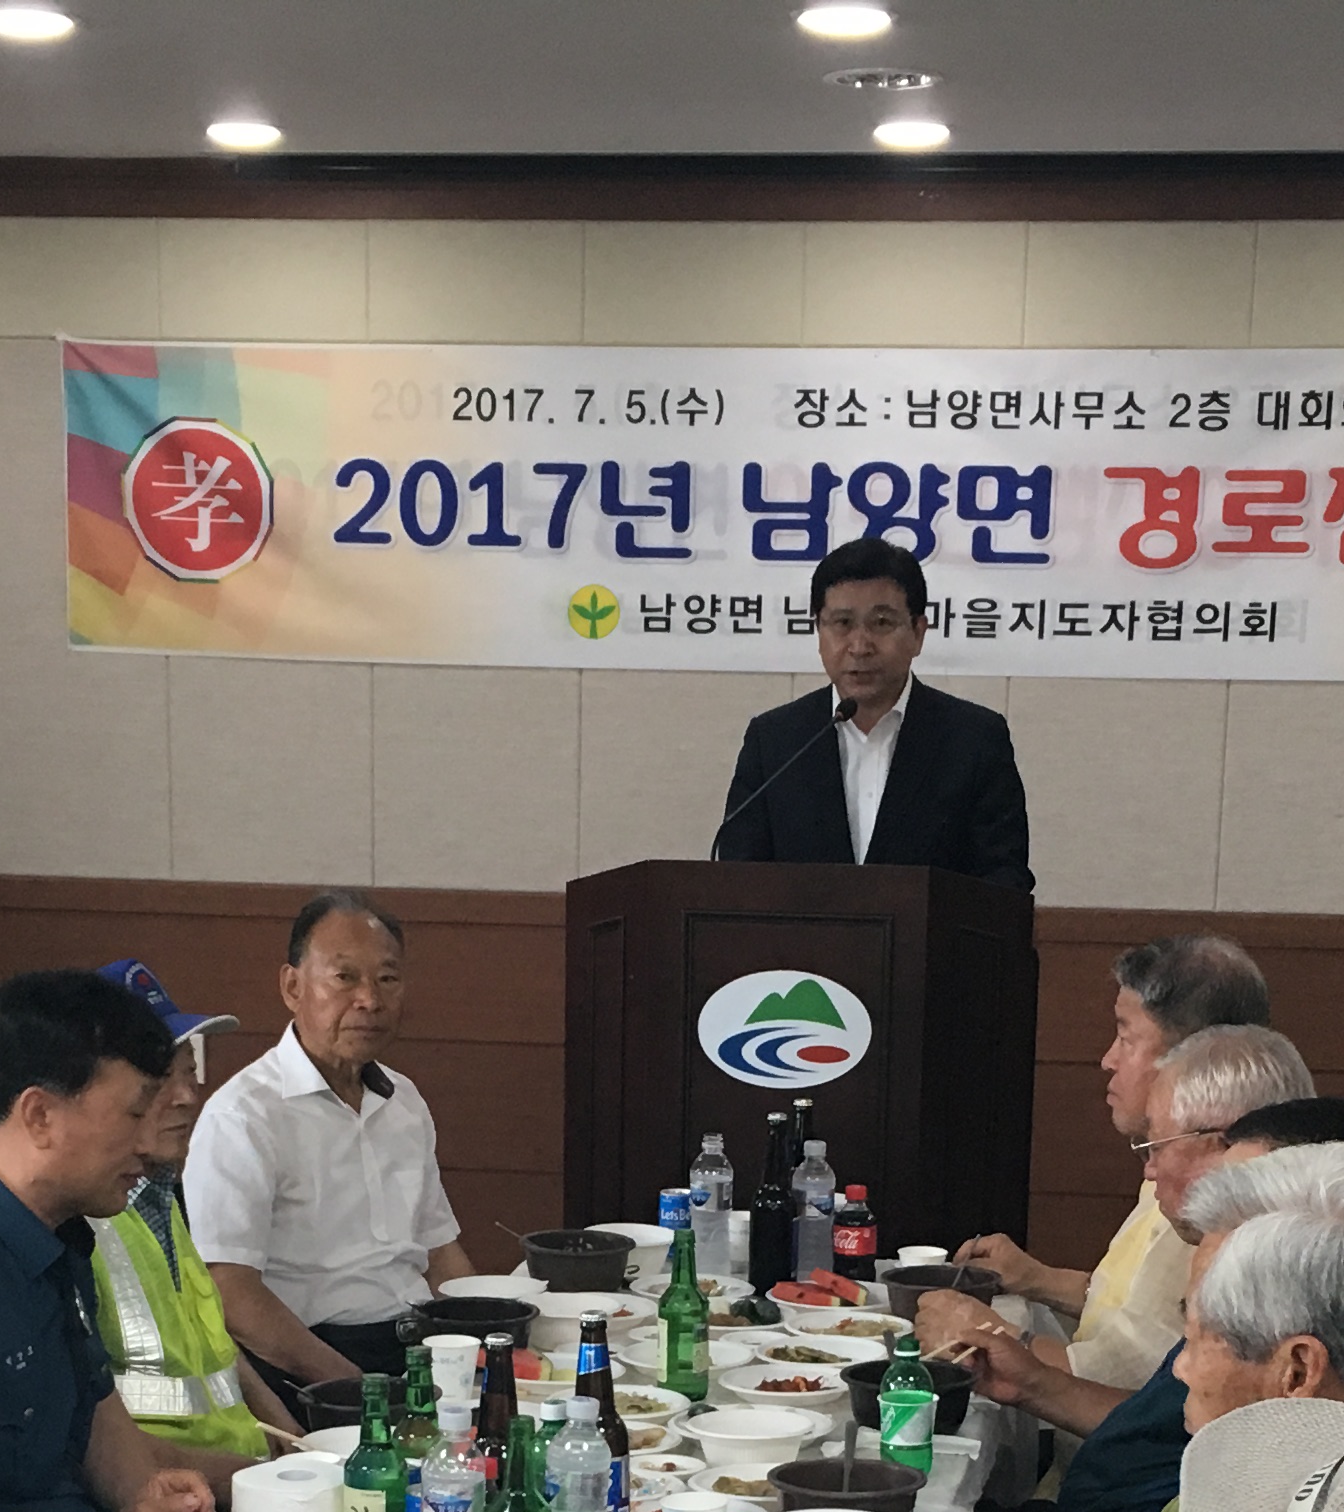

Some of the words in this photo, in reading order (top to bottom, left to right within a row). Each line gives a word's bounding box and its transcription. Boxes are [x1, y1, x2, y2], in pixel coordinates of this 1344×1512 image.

[452, 386, 555, 425] 2017.
[574, 388, 606, 425] 7.
[793, 387, 869, 428] 장소
[906, 388, 1147, 431] 남양면사무소
[1168, 389, 1232, 432] 2층
[151, 451, 244, 552] 孝
[334, 459, 692, 559] 2017년
[743, 461, 1053, 564] 남양면
[639, 593, 764, 636] 남양면
